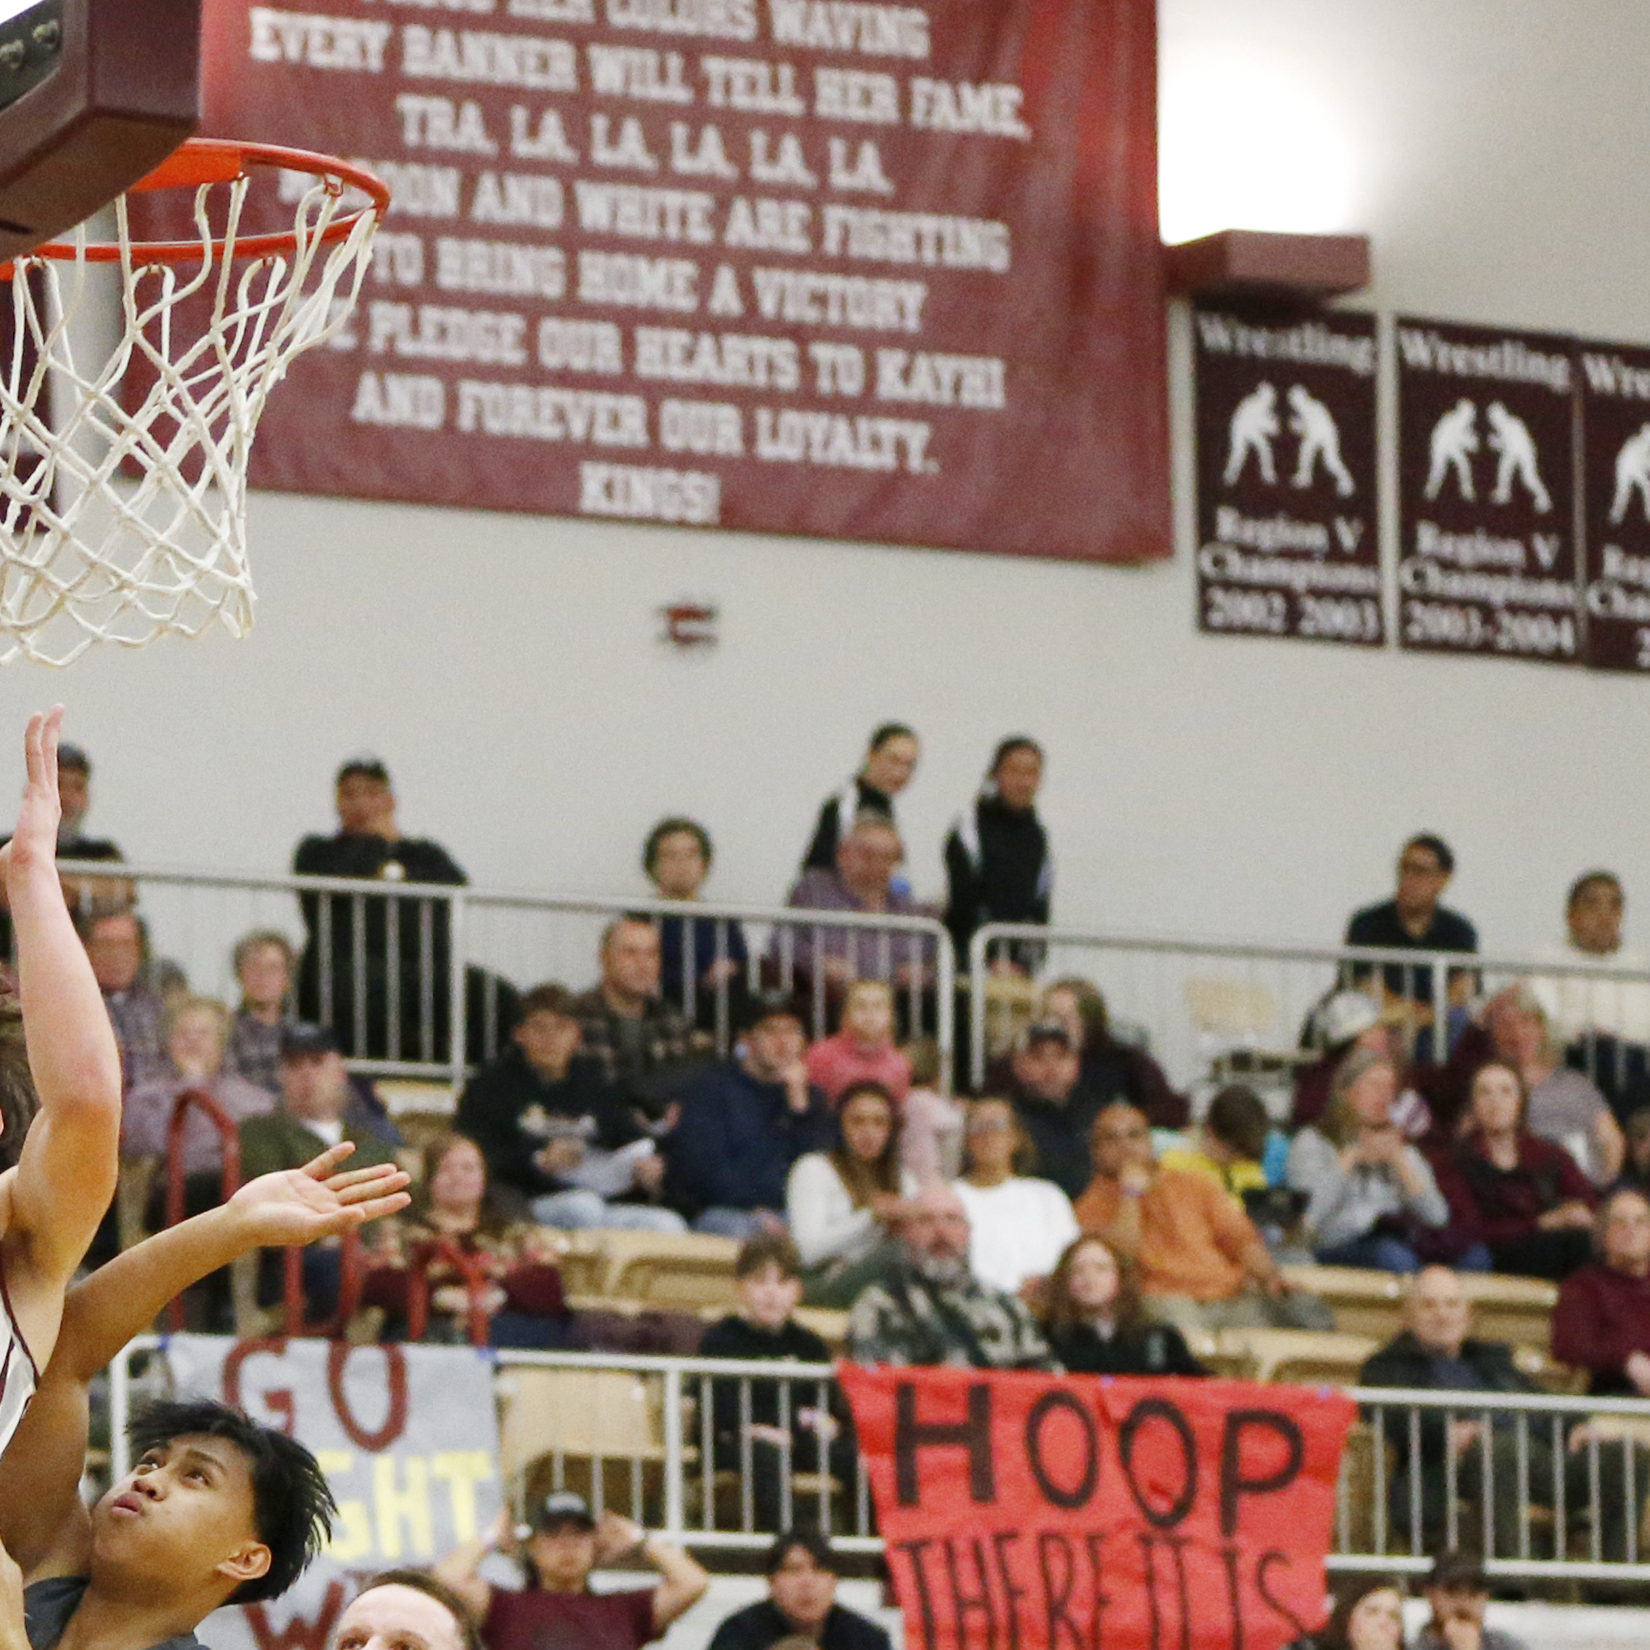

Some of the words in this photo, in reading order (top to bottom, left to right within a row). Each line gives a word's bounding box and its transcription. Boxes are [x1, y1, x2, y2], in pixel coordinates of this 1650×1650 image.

[250, 7, 391, 75] EVERY
[403, 24, 578, 92] BANNER
[588, 43, 694, 103] WILL
[702, 57, 805, 115] TELL
[815, 67, 900, 124] HER
[471, 170, 563, 229] AND
[574, 180, 715, 246] WHITE
[723, 195, 813, 254] ARE
[821, 204, 1011, 275] FIGHTING
[436, 236, 567, 300] BRING
[578, 250, 698, 313] HOME
[707, 262, 745, 318] A
[753, 266, 929, 334] VICTORY
[368, 301, 528, 366] PLEDGE
[537, 316, 624, 375] OUR
[634, 326, 800, 392] HEARTS
[807, 340, 865, 397] TO
[1199, 312, 1375, 376] Wrestling
[1399, 326, 1572, 393] Wrestling
[351, 369, 447, 431] AND
[457, 379, 648, 449] FOREVER
[660, 398, 743, 457] OUR
[895, 1382, 1304, 1538] HOOP
